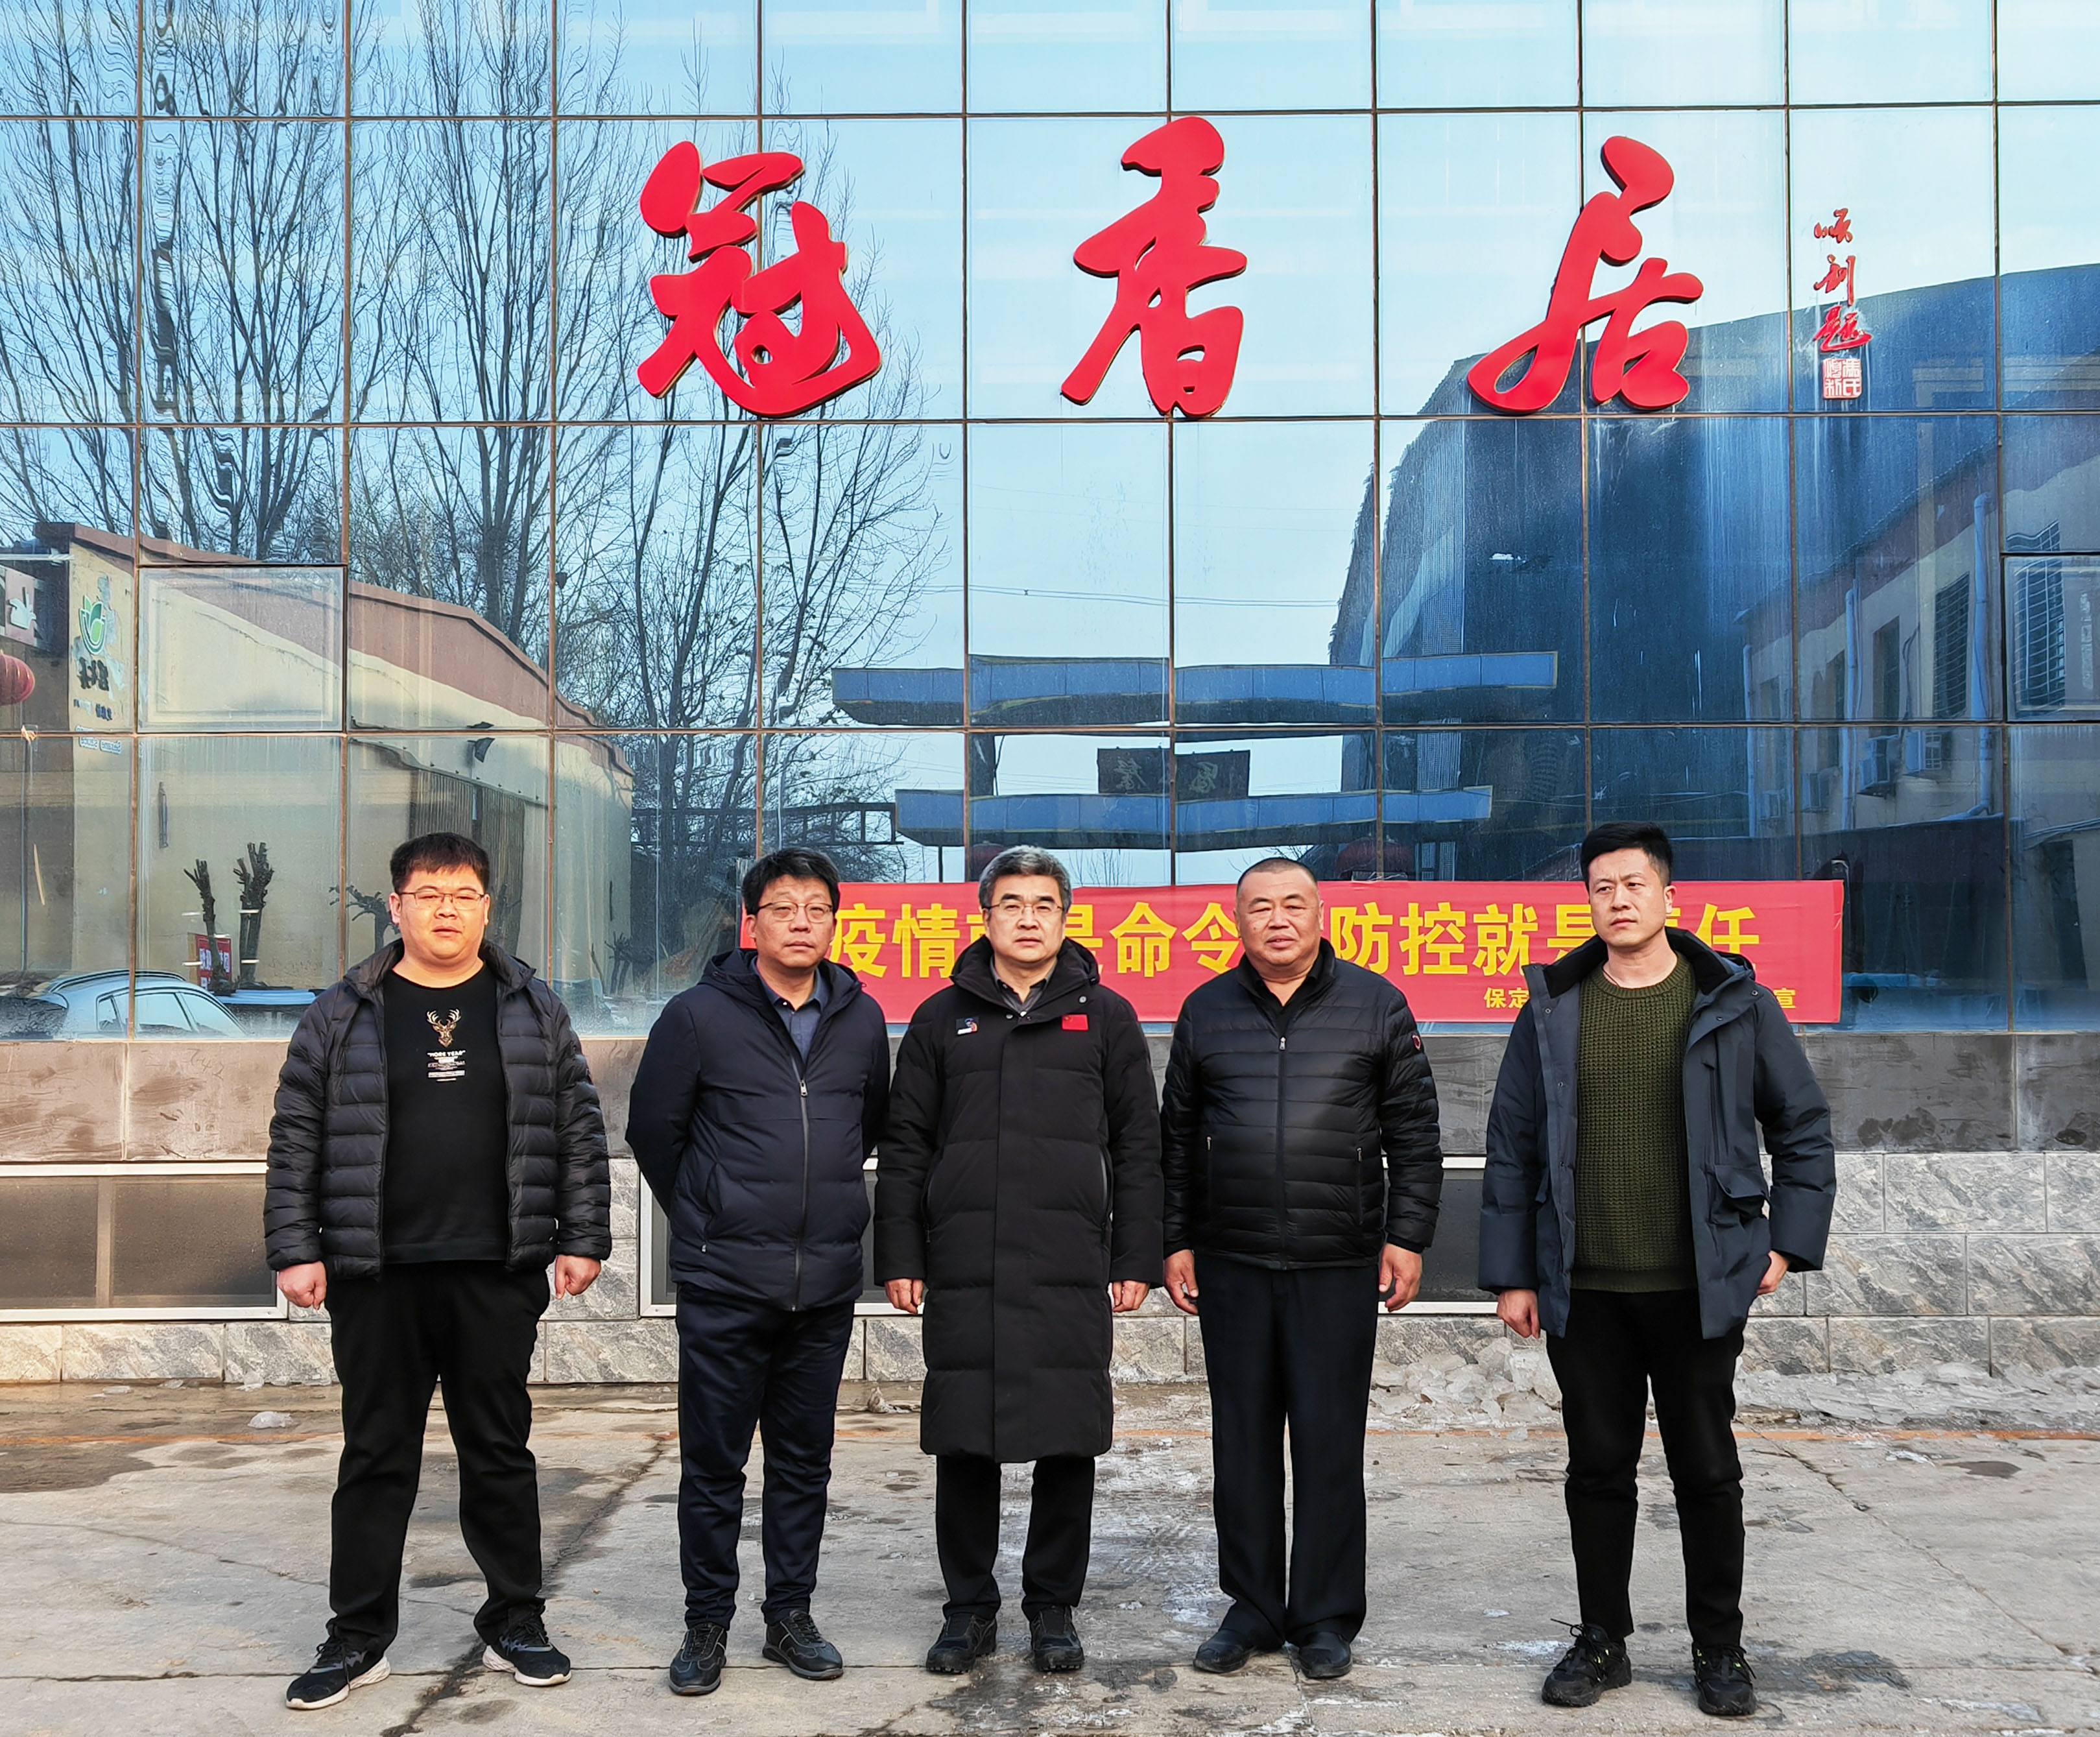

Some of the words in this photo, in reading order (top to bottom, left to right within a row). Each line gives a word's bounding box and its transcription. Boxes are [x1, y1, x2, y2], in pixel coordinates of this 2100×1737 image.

[637, 116, 1704, 418] 冠香居
[829, 902, 1240, 978] 疫情命令
[1330, 901, 1760, 976] 防控就任
